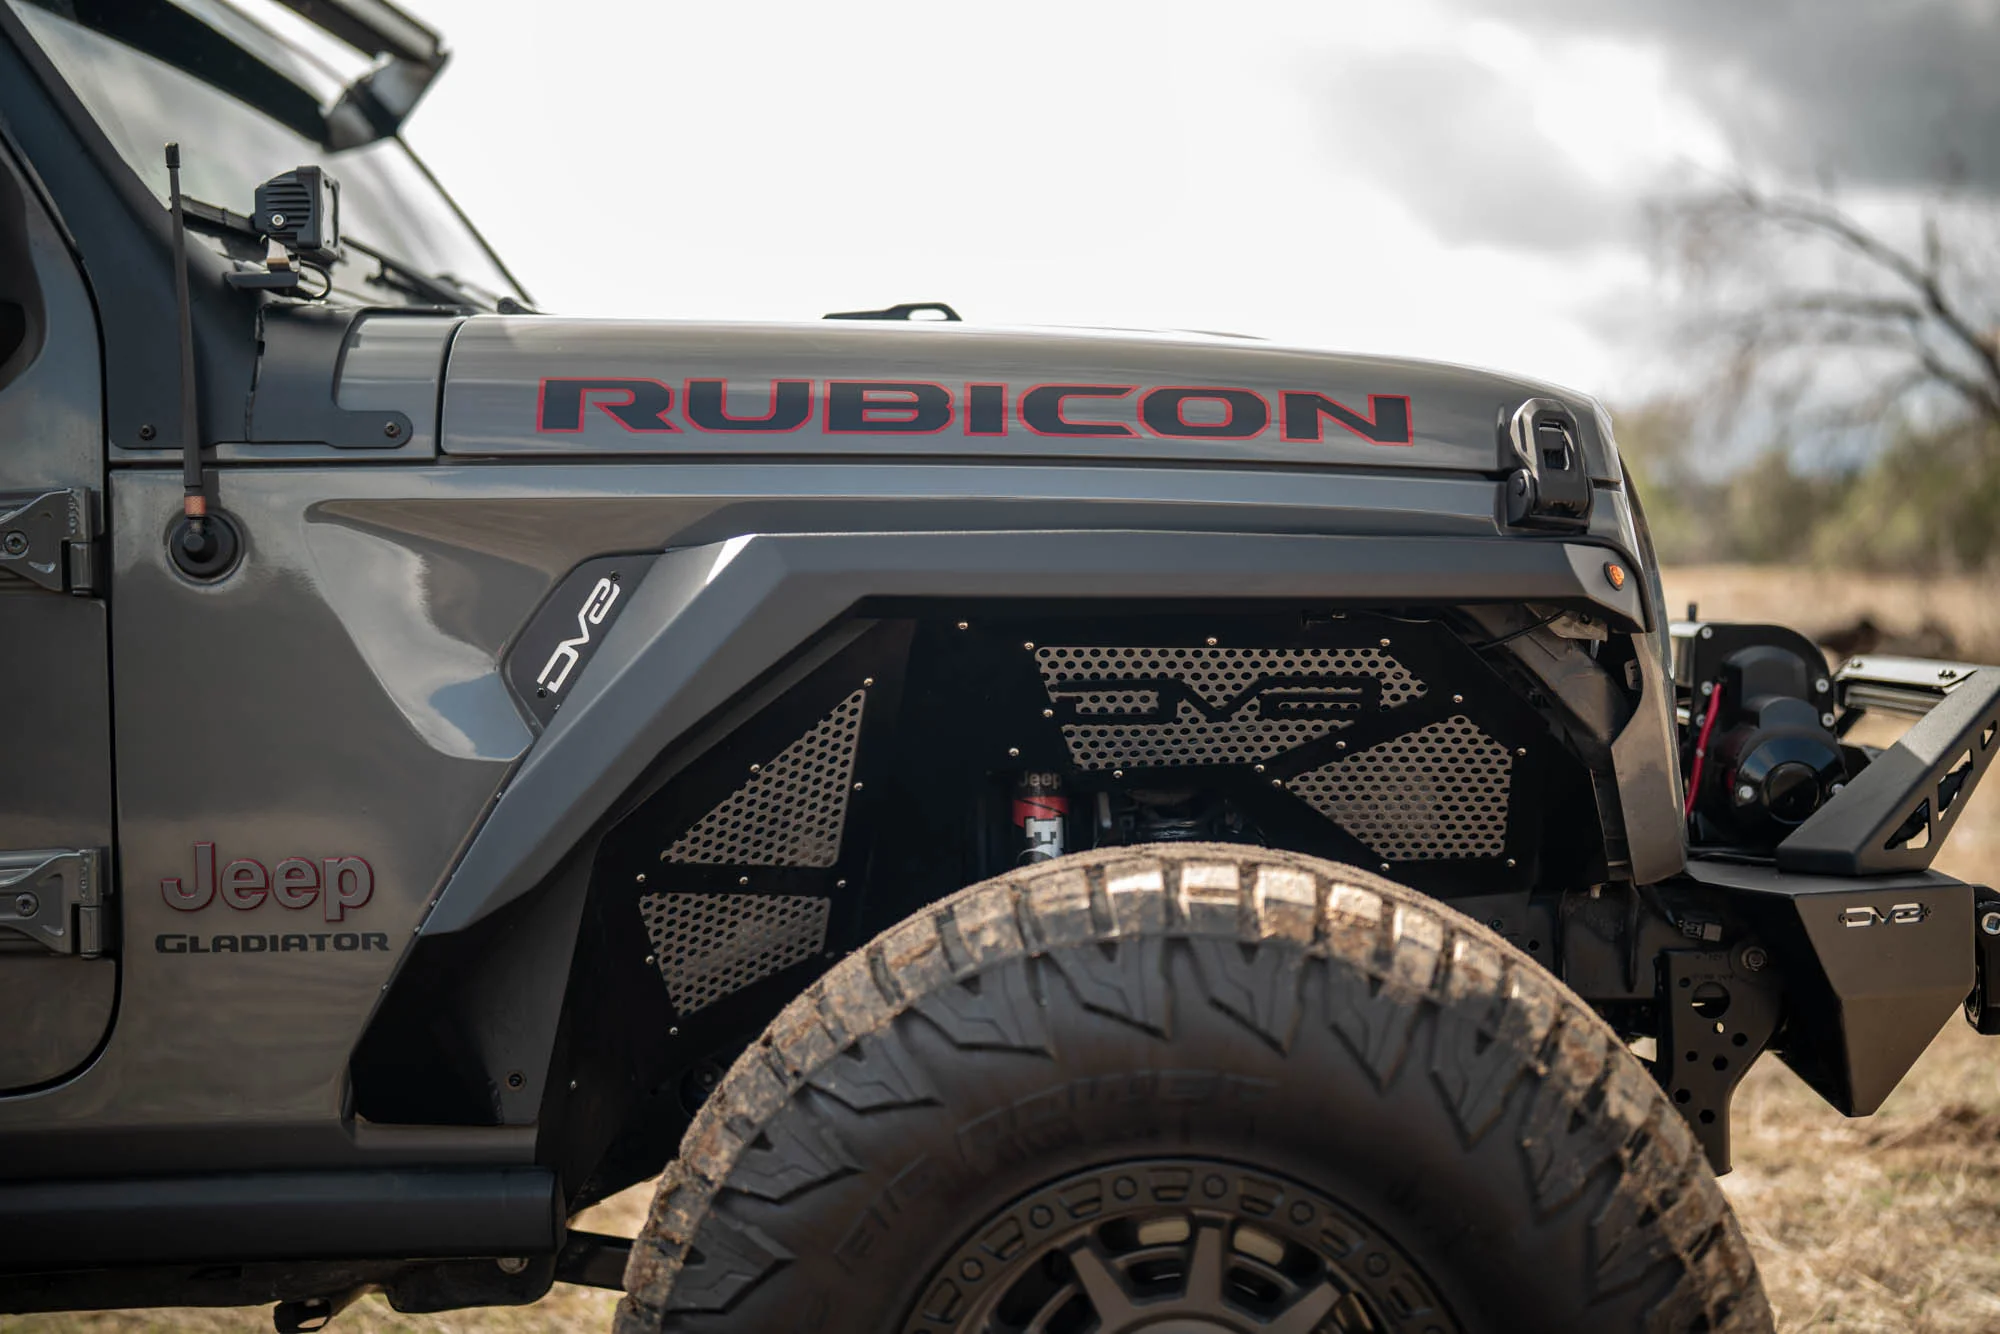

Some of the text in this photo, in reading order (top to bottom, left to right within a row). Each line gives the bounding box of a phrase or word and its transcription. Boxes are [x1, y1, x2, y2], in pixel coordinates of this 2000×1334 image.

[536, 377, 1414, 446] RUBICON
[160, 841, 375, 922] Jeep
[155, 931, 391, 954] GLADIATOR
